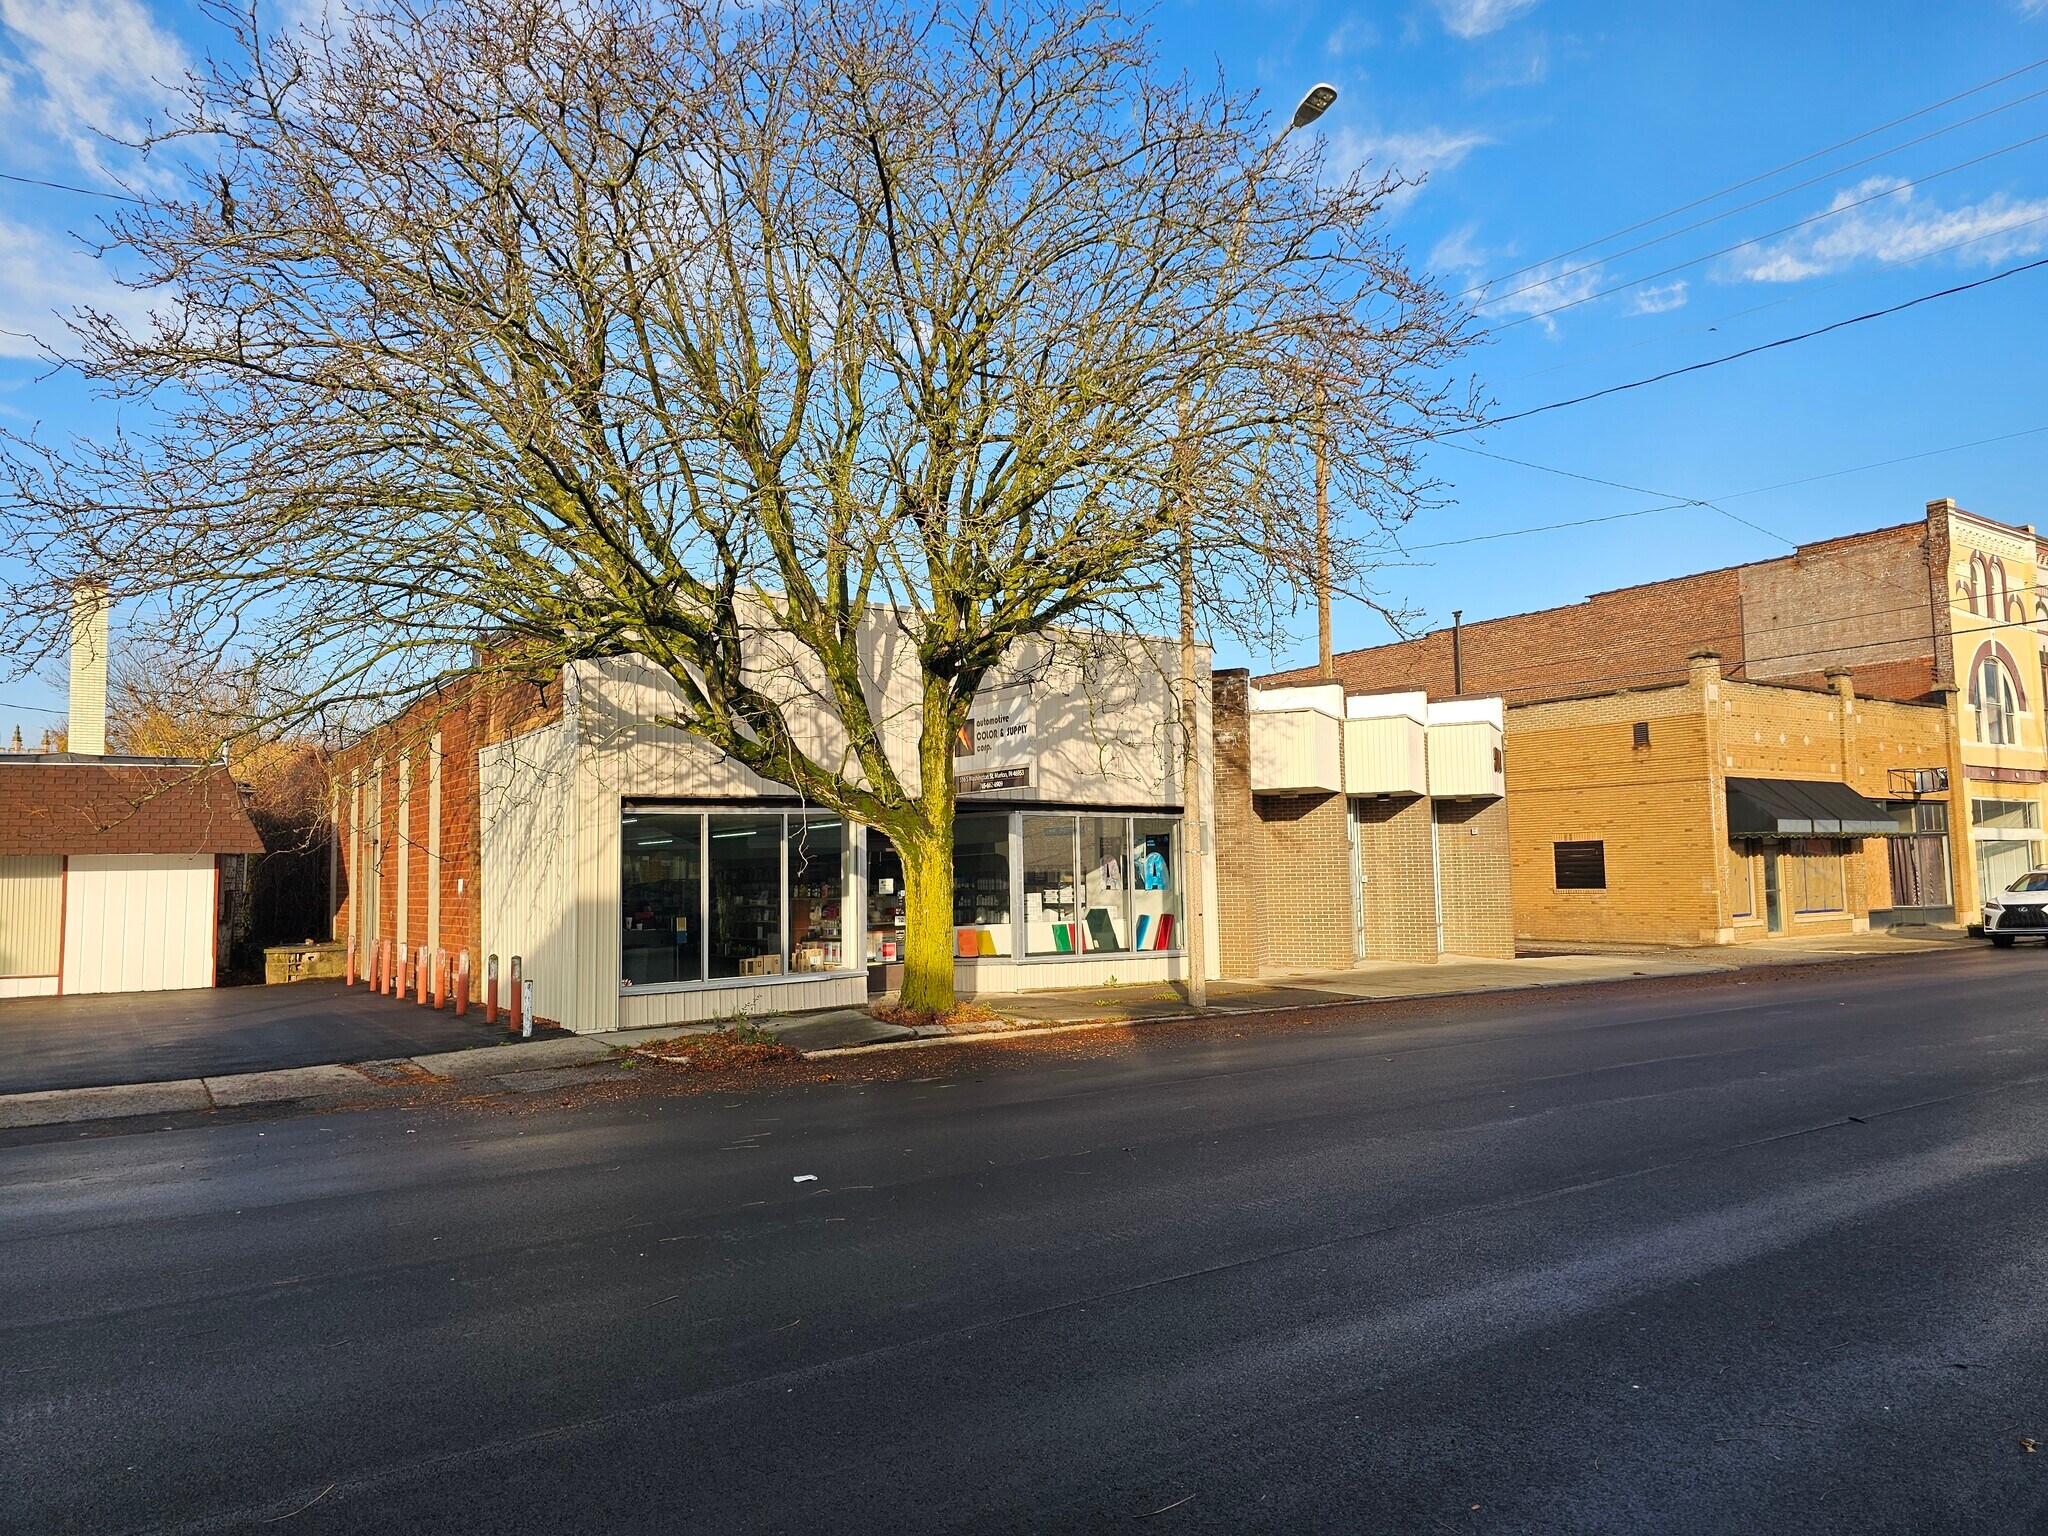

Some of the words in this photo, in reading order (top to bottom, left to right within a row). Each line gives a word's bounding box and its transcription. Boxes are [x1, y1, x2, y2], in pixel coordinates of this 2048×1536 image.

[976, 714, 1009, 727] automotive
[976, 729, 998, 741] COLOR
[1000, 728, 1004, 737] &
[1007, 724, 1028, 736] SUPPLY
[976, 744, 992, 753] corp.
